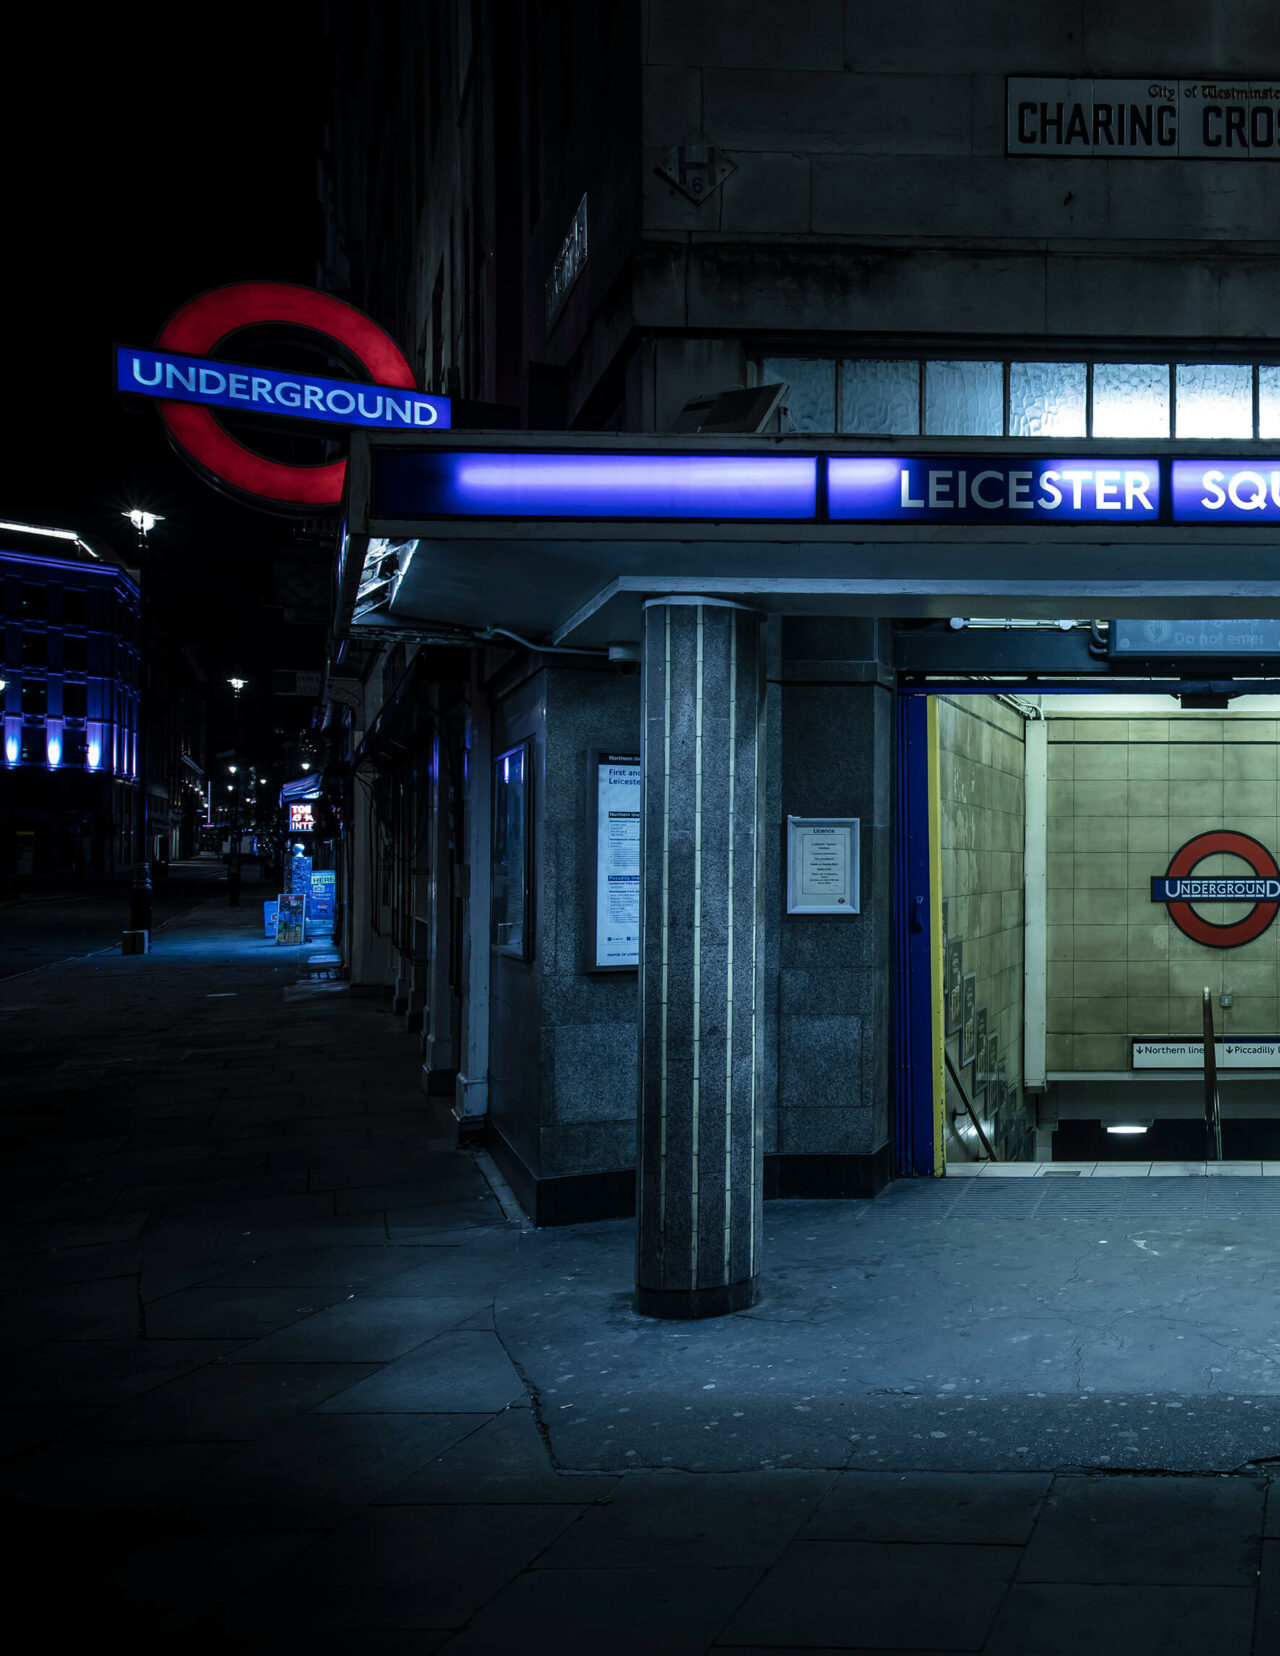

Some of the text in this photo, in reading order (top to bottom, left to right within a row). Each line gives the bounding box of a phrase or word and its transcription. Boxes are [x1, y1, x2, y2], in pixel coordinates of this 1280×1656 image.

[1148, 84, 1175, 102] City
[1184, 85, 1198, 99] of
[1017, 102, 1177, 147] CHARING
[678, 145, 715, 185] H
[692, 177, 703, 194] 6
[132, 358, 438, 426] UNDERGROUND
[900, 468, 1155, 513] LEICESTER
[1174, 631, 1196, 646] Do
[1200, 631, 1223, 646] not
[609, 778, 641, 786] Leiceste
[1165, 879, 1280, 898] UNDERGROUND
[1144, 1046, 1205, 1054] Northern line
[1234, 1046, 1274, 1056] Piccadilly
